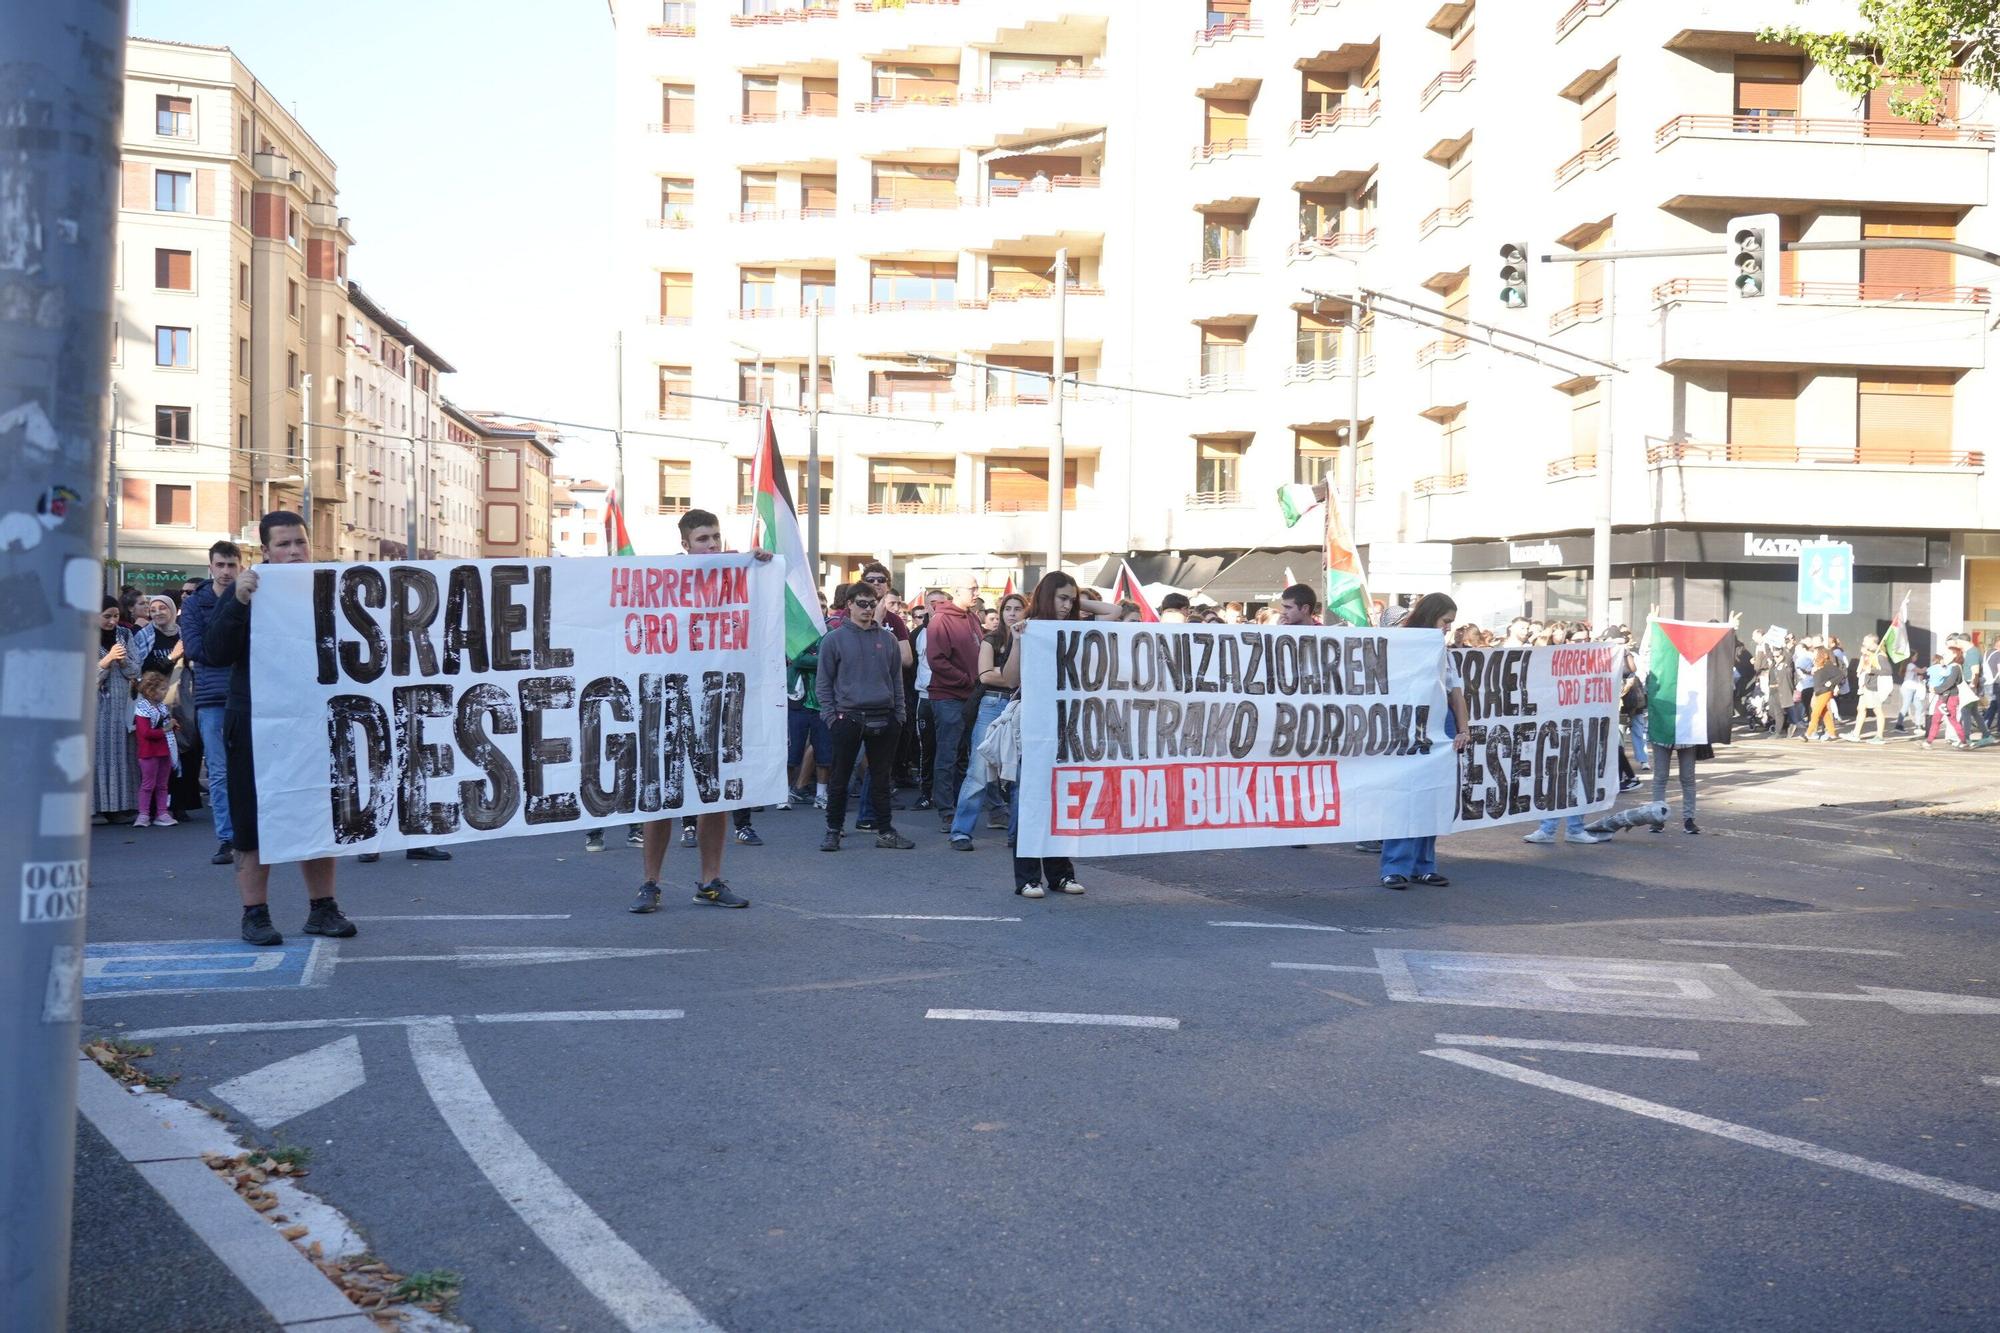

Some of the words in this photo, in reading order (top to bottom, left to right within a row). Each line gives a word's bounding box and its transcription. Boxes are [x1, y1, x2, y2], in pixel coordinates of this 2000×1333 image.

[609, 567, 749, 608] HARREMAN
[313, 565, 574, 684] ISRAEL
[624, 612, 678, 655] ORO
[689, 610, 750, 651] ETEN
[1056, 629, 1389, 695] KOLONIZAZIOAREN
[1453, 650, 1537, 720] RAEL
[1551, 647, 1613, 677] HARREMAN
[1557, 678, 1581, 706] ORO
[1584, 677, 1613, 704] ETEN
[327, 671, 745, 845] DESEGIN!
[1056, 696, 1259, 763] KONTRAKO
[1055, 769, 1106, 830] EZ
[1120, 769, 1169, 828] DA
[1184, 764, 1337, 826] BUKATU!
[1454, 716, 1610, 822] ESEGIN!
